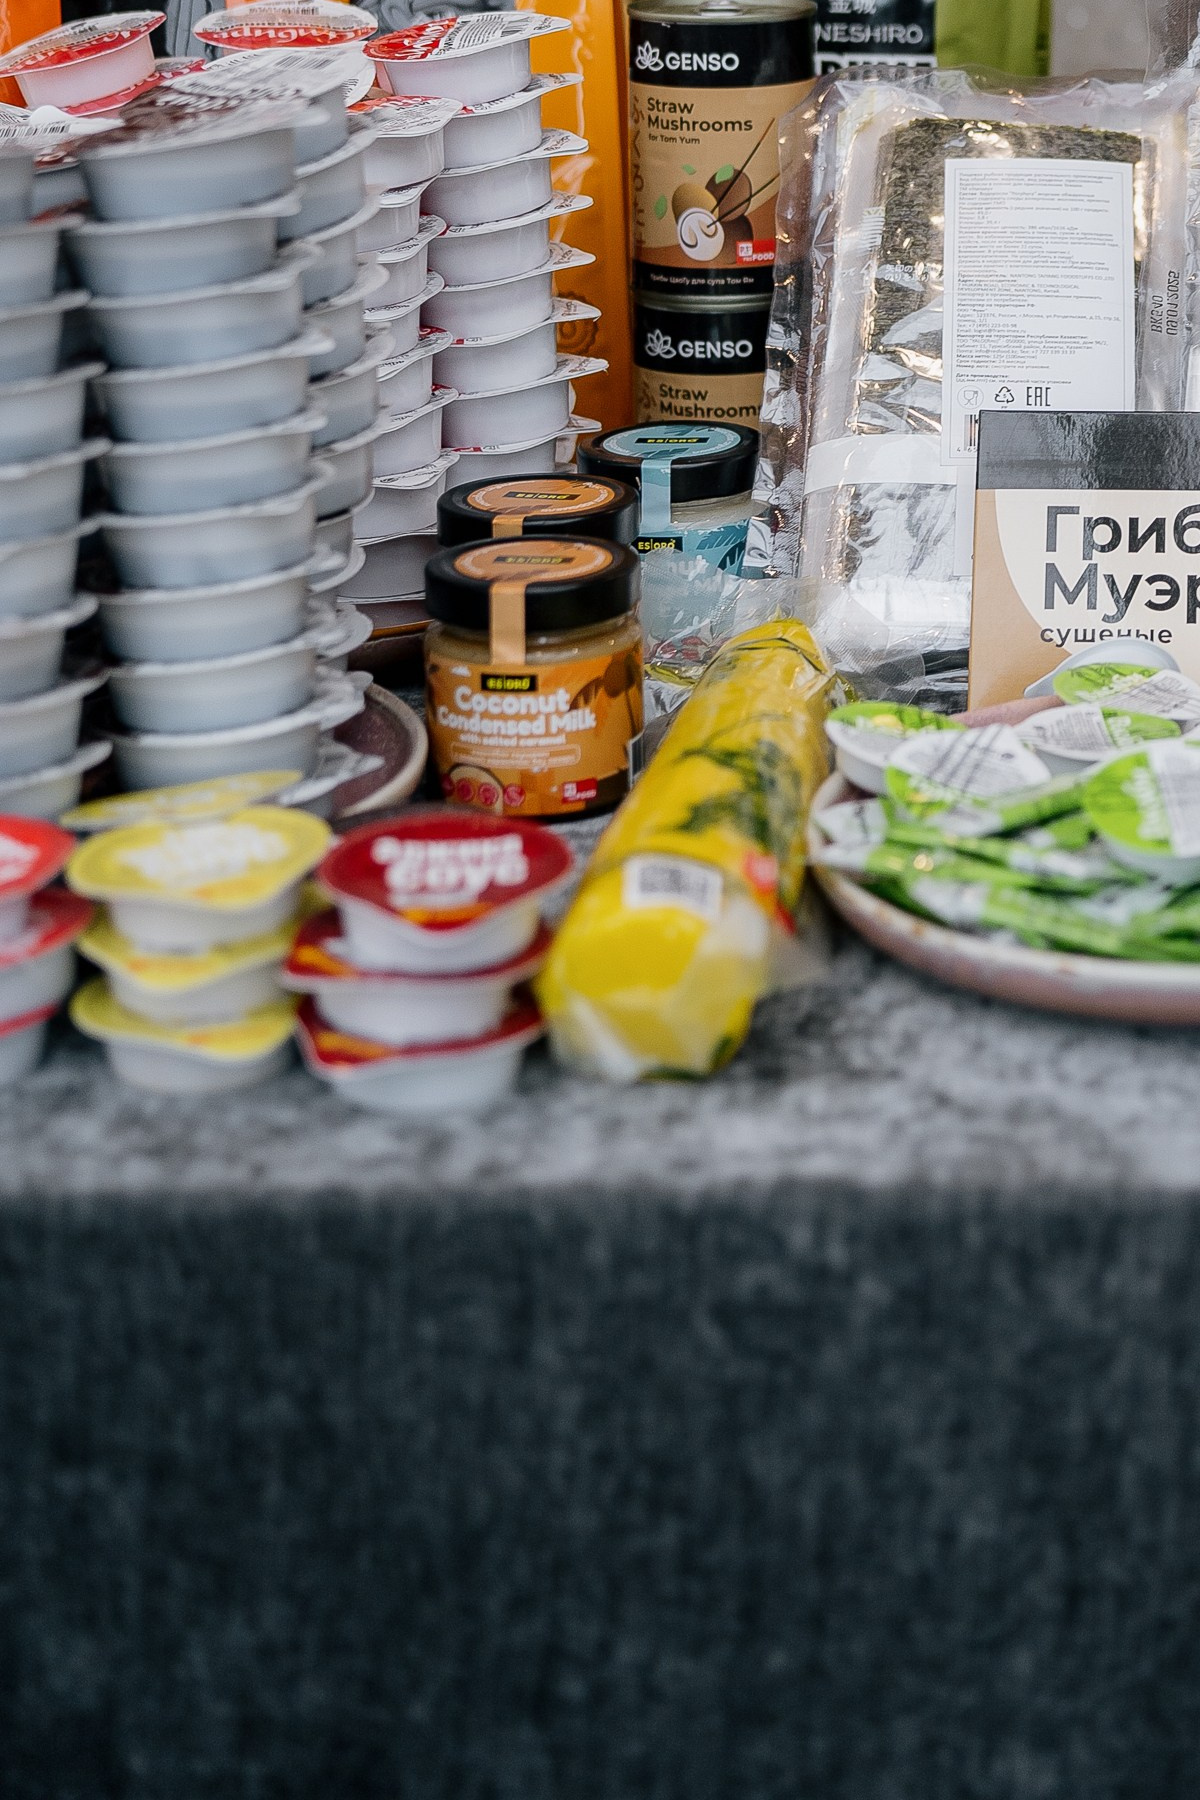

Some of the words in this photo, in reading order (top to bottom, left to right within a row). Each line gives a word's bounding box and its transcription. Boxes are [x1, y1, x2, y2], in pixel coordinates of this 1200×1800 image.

[814, 23, 923, 44] NESHIRO
[665, 52, 739, 71] GENSO
[647, 97, 694, 114] Straw
[647, 114, 753, 131] Mushrooms
[648, 133, 658, 141] for
[660, 134, 677, 143] Tom
[680, 136, 700, 144] Yum
[677, 340, 753, 358] GENSO
[659, 384, 708, 401] Straw
[1040, 628, 1172, 647] сушеные
[454, 685, 571, 715] Coconut
[436, 706, 546, 735] Condensed
[551, 707, 597, 734] Milk
[482, 735, 517, 746] salted
[519, 734, 566, 746] caramel
